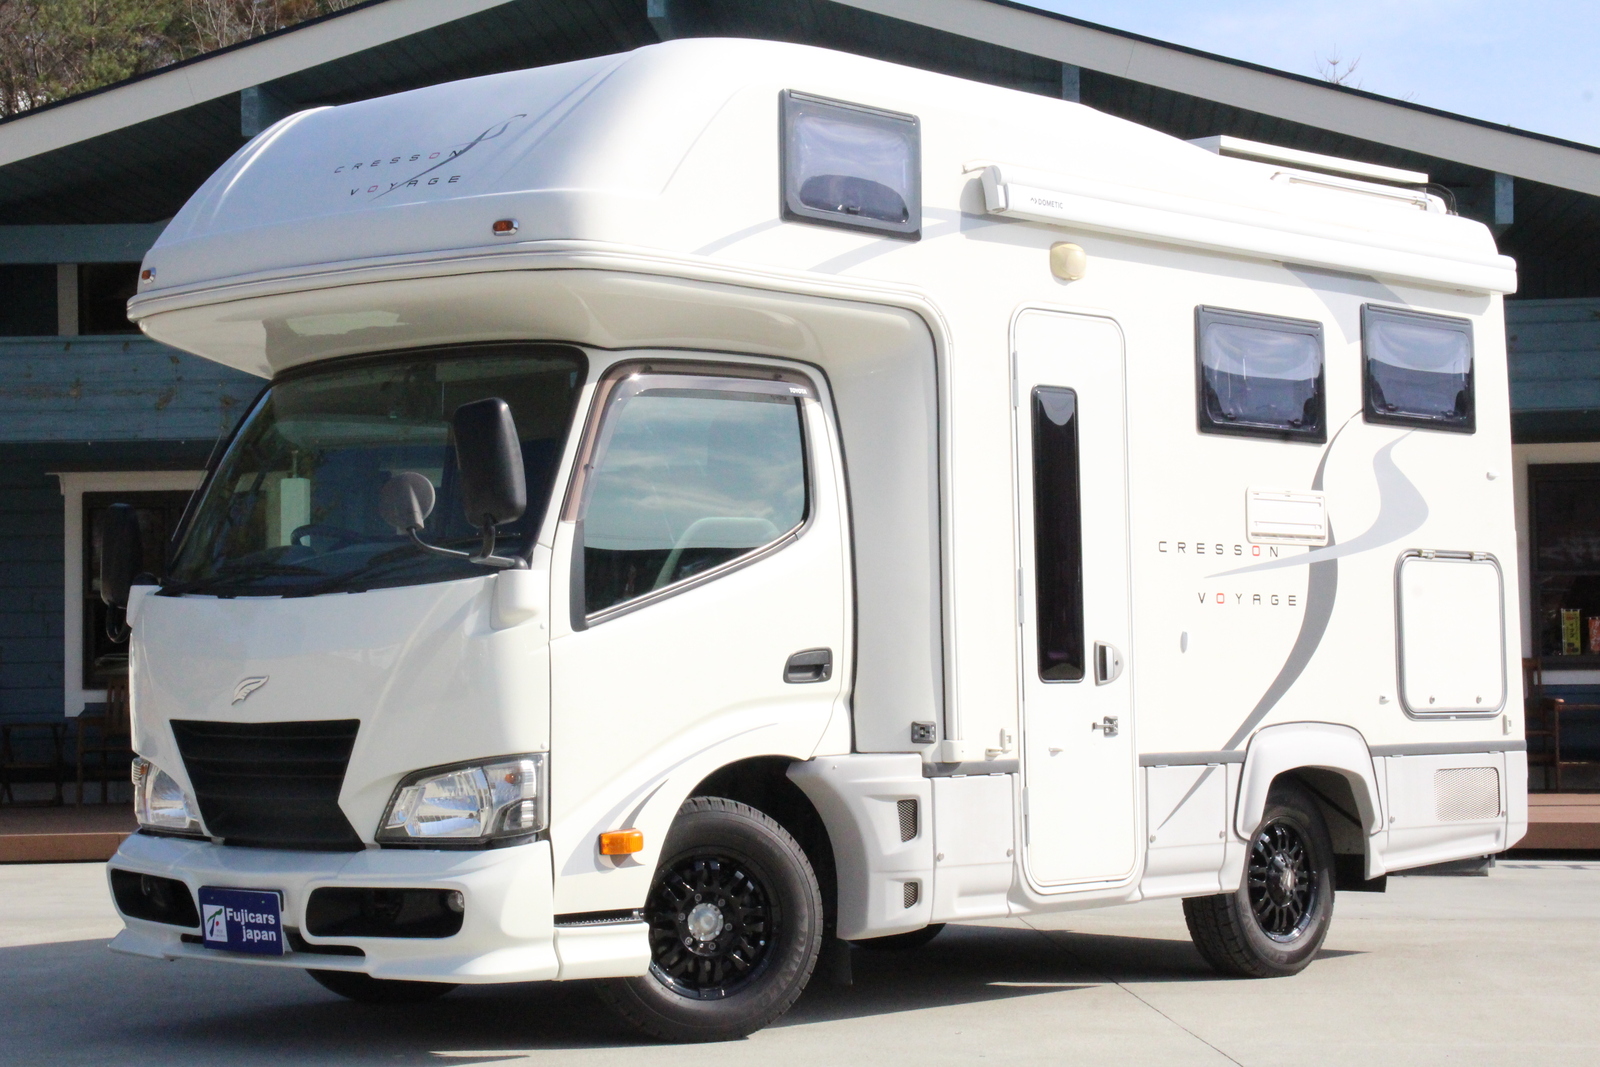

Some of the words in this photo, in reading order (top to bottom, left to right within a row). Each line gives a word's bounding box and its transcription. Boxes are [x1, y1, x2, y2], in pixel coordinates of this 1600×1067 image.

[334, 150, 463, 174] CRESSON
[350, 175, 461, 196] VOYAGE
[1038, 198, 1063, 209] DOMETIC
[1158, 541, 1278, 557] CRESSON
[1197, 592, 1297, 607] VOYAGE
[226, 907, 275, 925] Fujicars
[242, 926, 276, 942] japan
